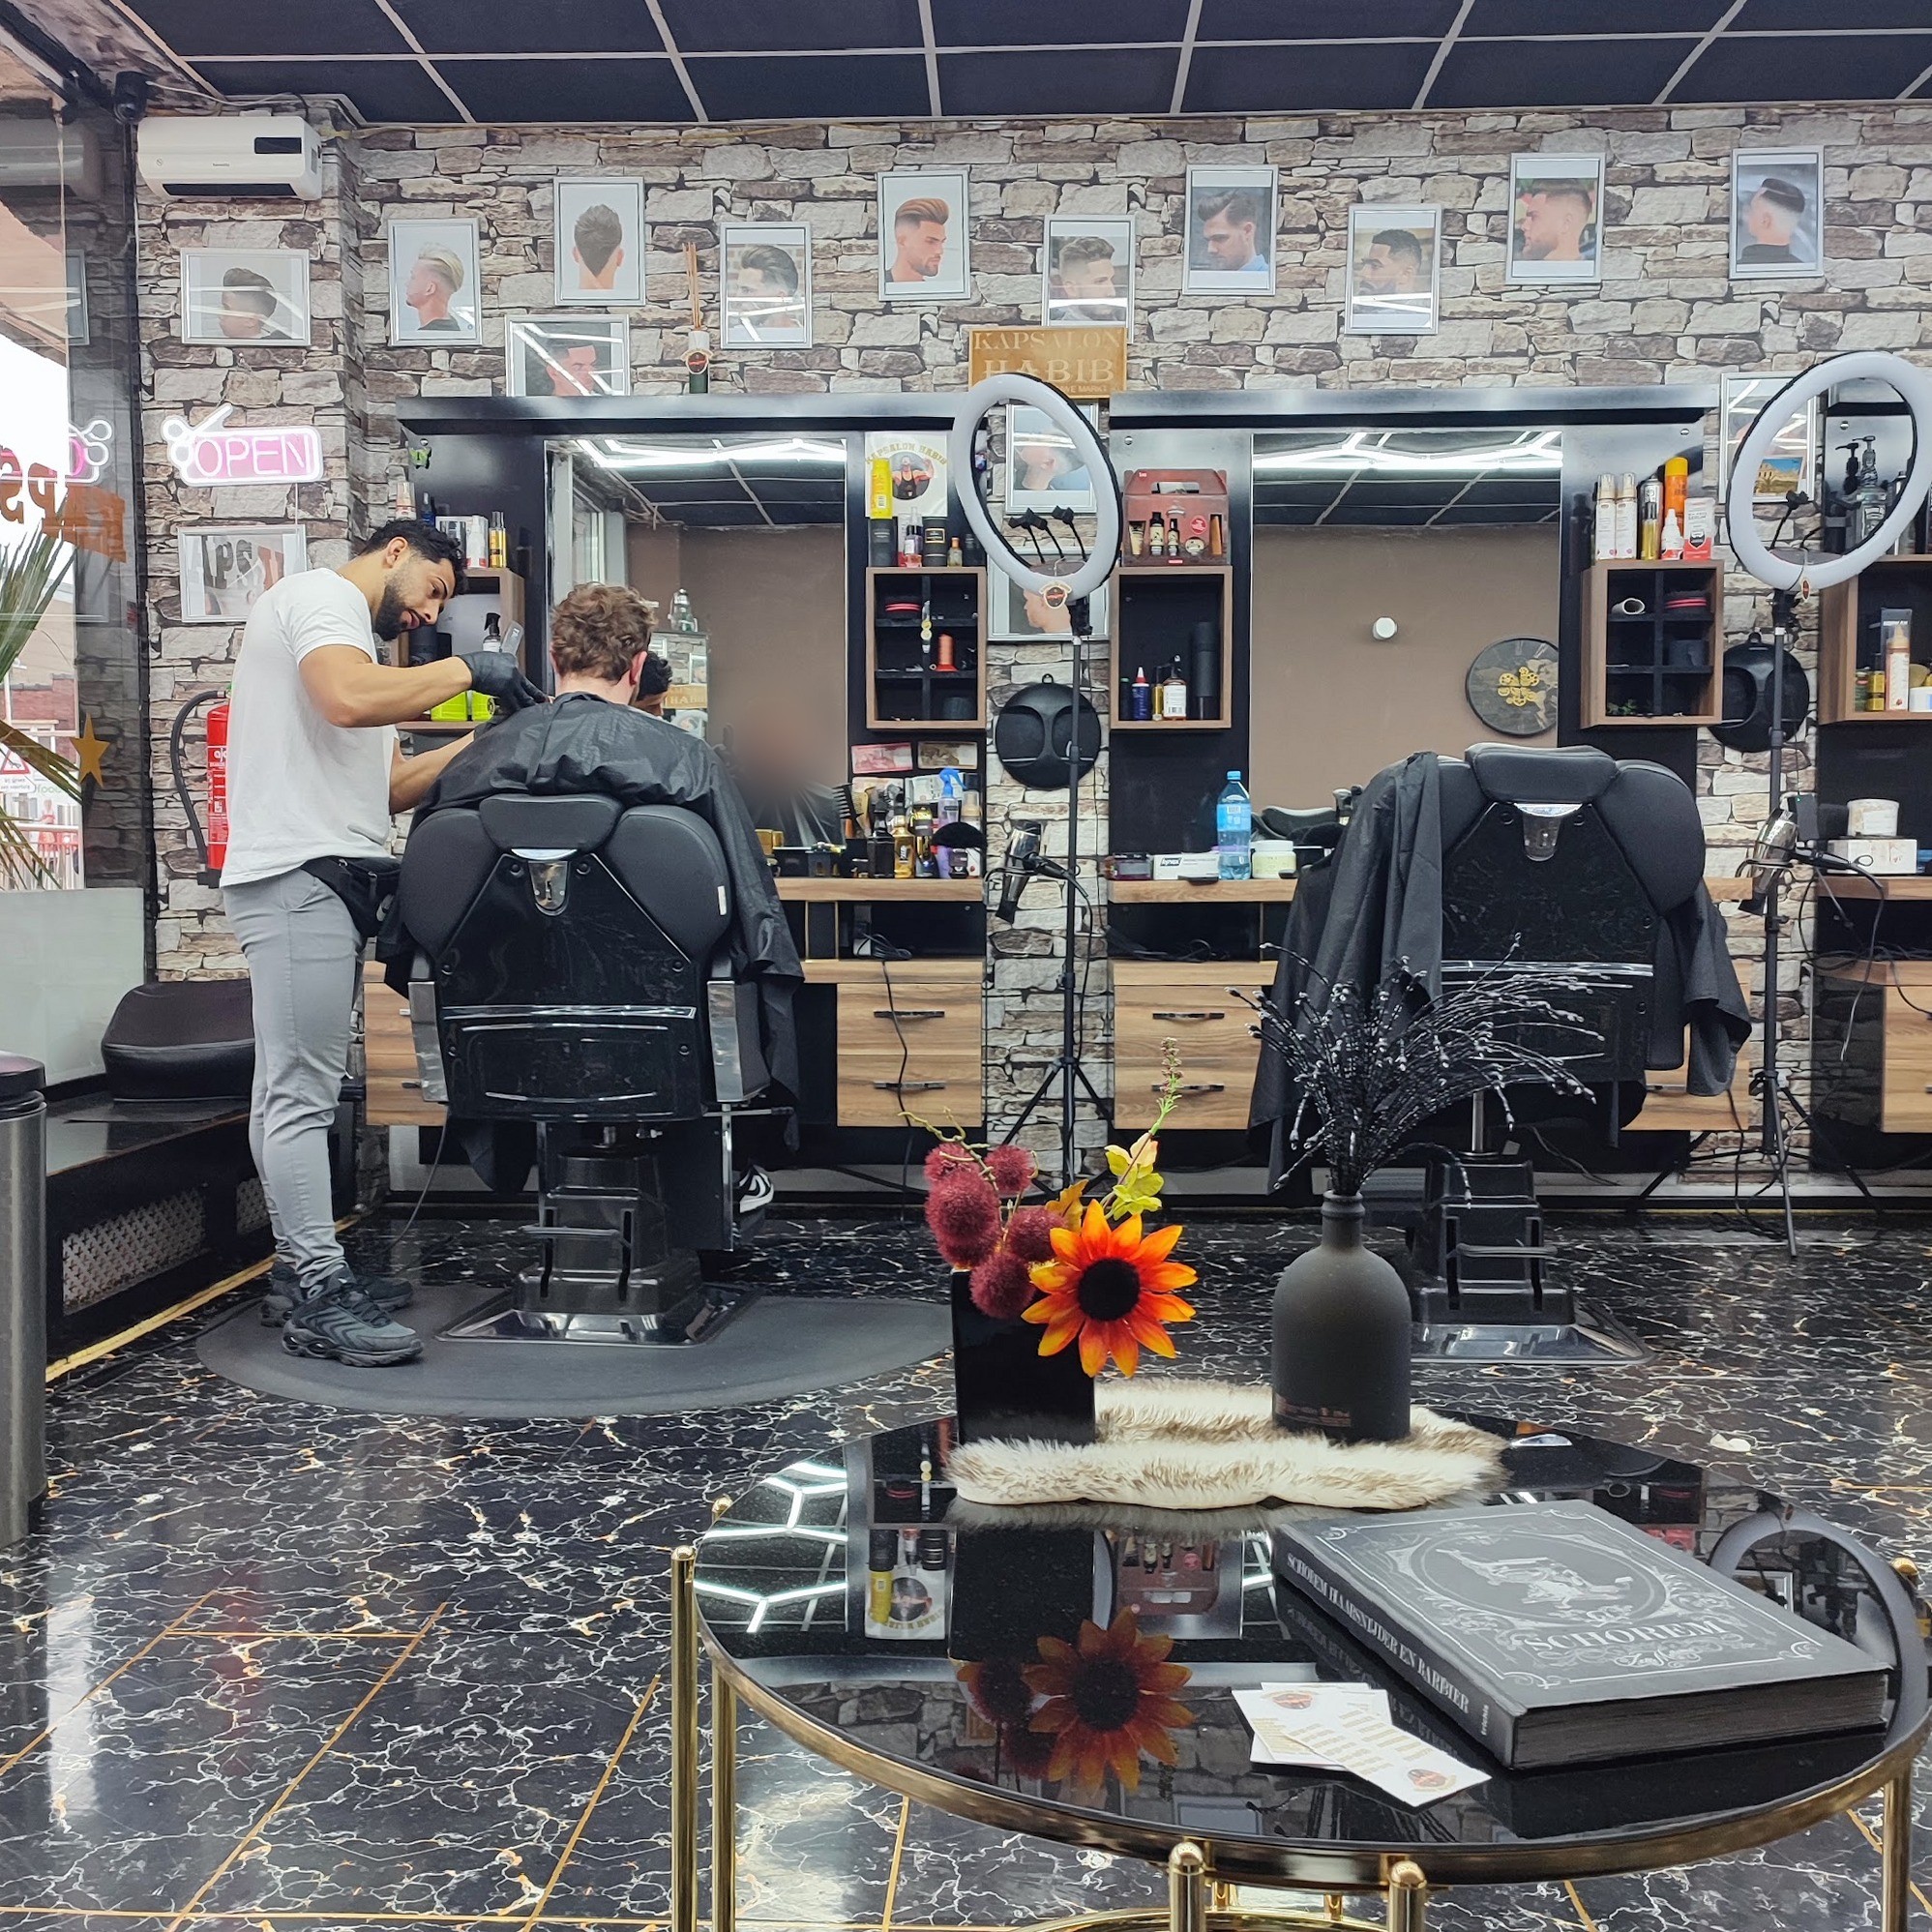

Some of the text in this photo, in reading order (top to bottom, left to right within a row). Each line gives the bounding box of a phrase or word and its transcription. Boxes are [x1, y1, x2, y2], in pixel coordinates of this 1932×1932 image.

[974, 330, 1121, 350] KAPSALON
[983, 359, 1115, 382] HABIB
[193, 435, 311, 477] OPEN
[1287, 1553, 1470, 1714] SCHOREM HAARSNIJDER EN BARBIER
[1524, 1620, 1731, 1651] SCHOREM
